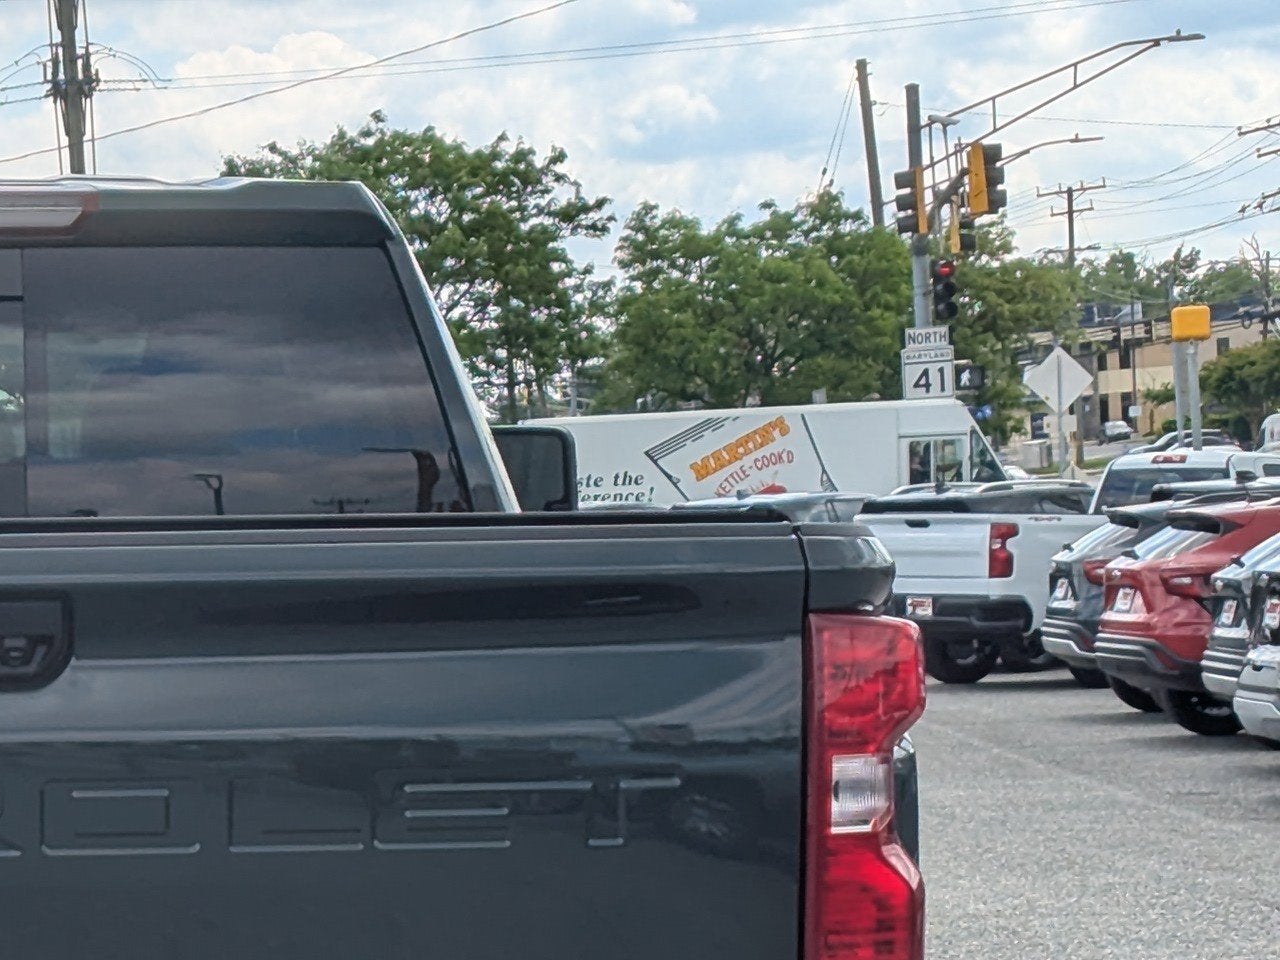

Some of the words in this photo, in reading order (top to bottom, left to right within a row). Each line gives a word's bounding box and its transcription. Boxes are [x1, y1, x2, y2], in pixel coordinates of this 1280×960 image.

[908, 331, 947, 345] NORTH
[913, 366, 946, 394] 41
[689, 415, 791, 482] MARTIN'S
[576, 474, 604, 489] ste
[613, 471, 645, 487] the
[578, 486, 655, 502] erence!
